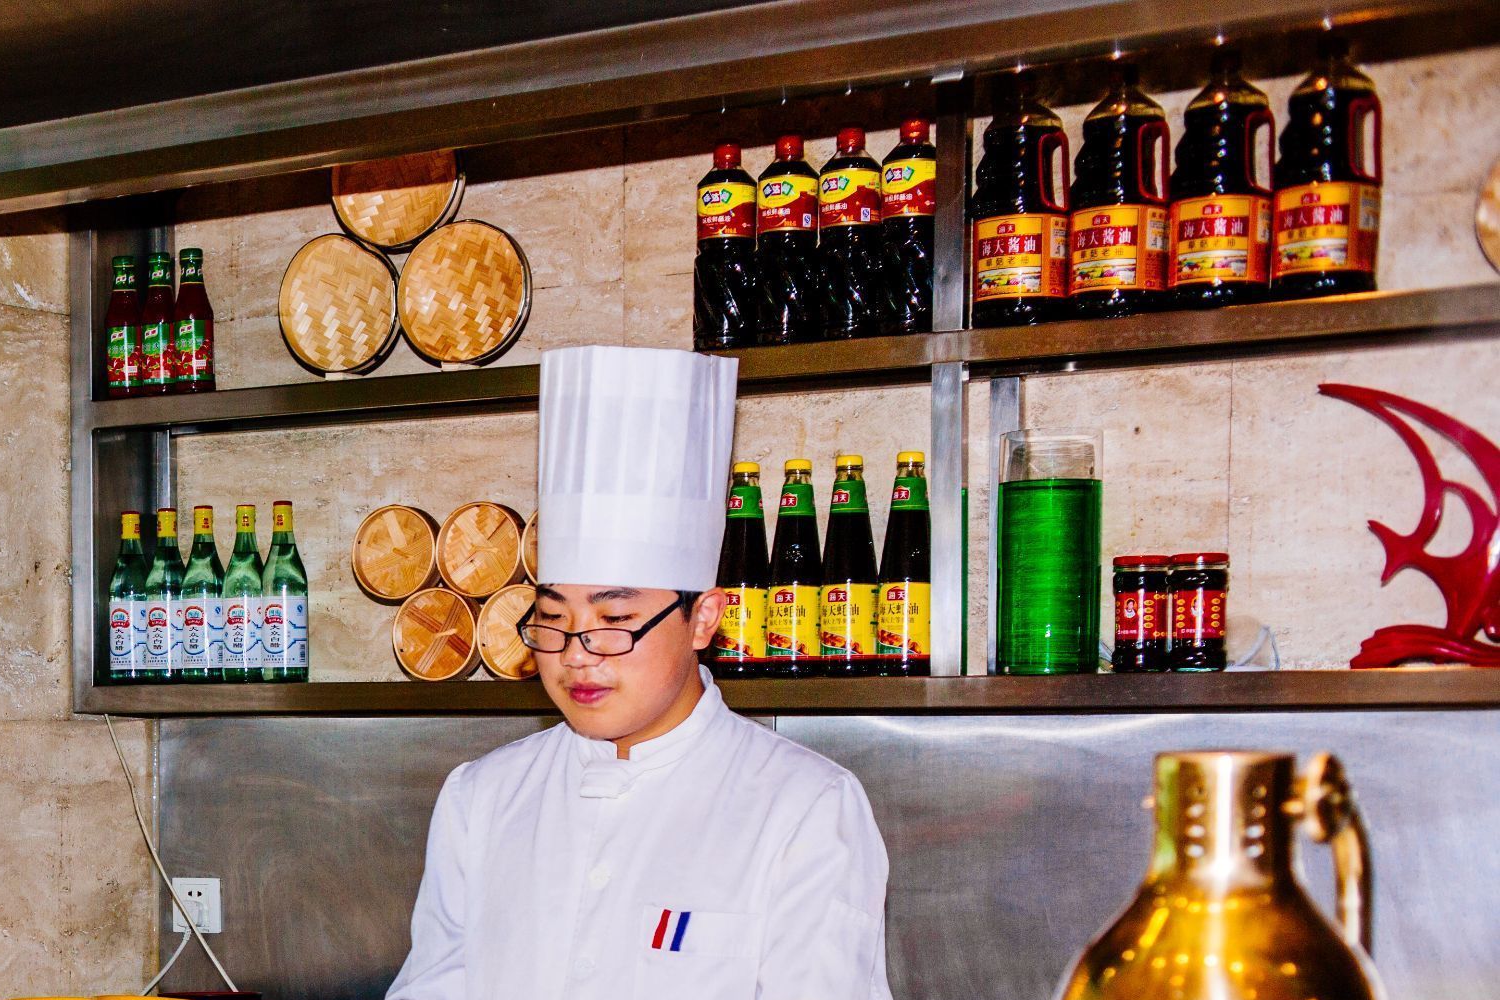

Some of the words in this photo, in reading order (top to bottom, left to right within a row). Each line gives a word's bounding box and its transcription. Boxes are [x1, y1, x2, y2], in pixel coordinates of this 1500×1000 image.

[982, 236, 1036, 257] 海天酱油
[1077, 227, 1131, 248] 海天酱油
